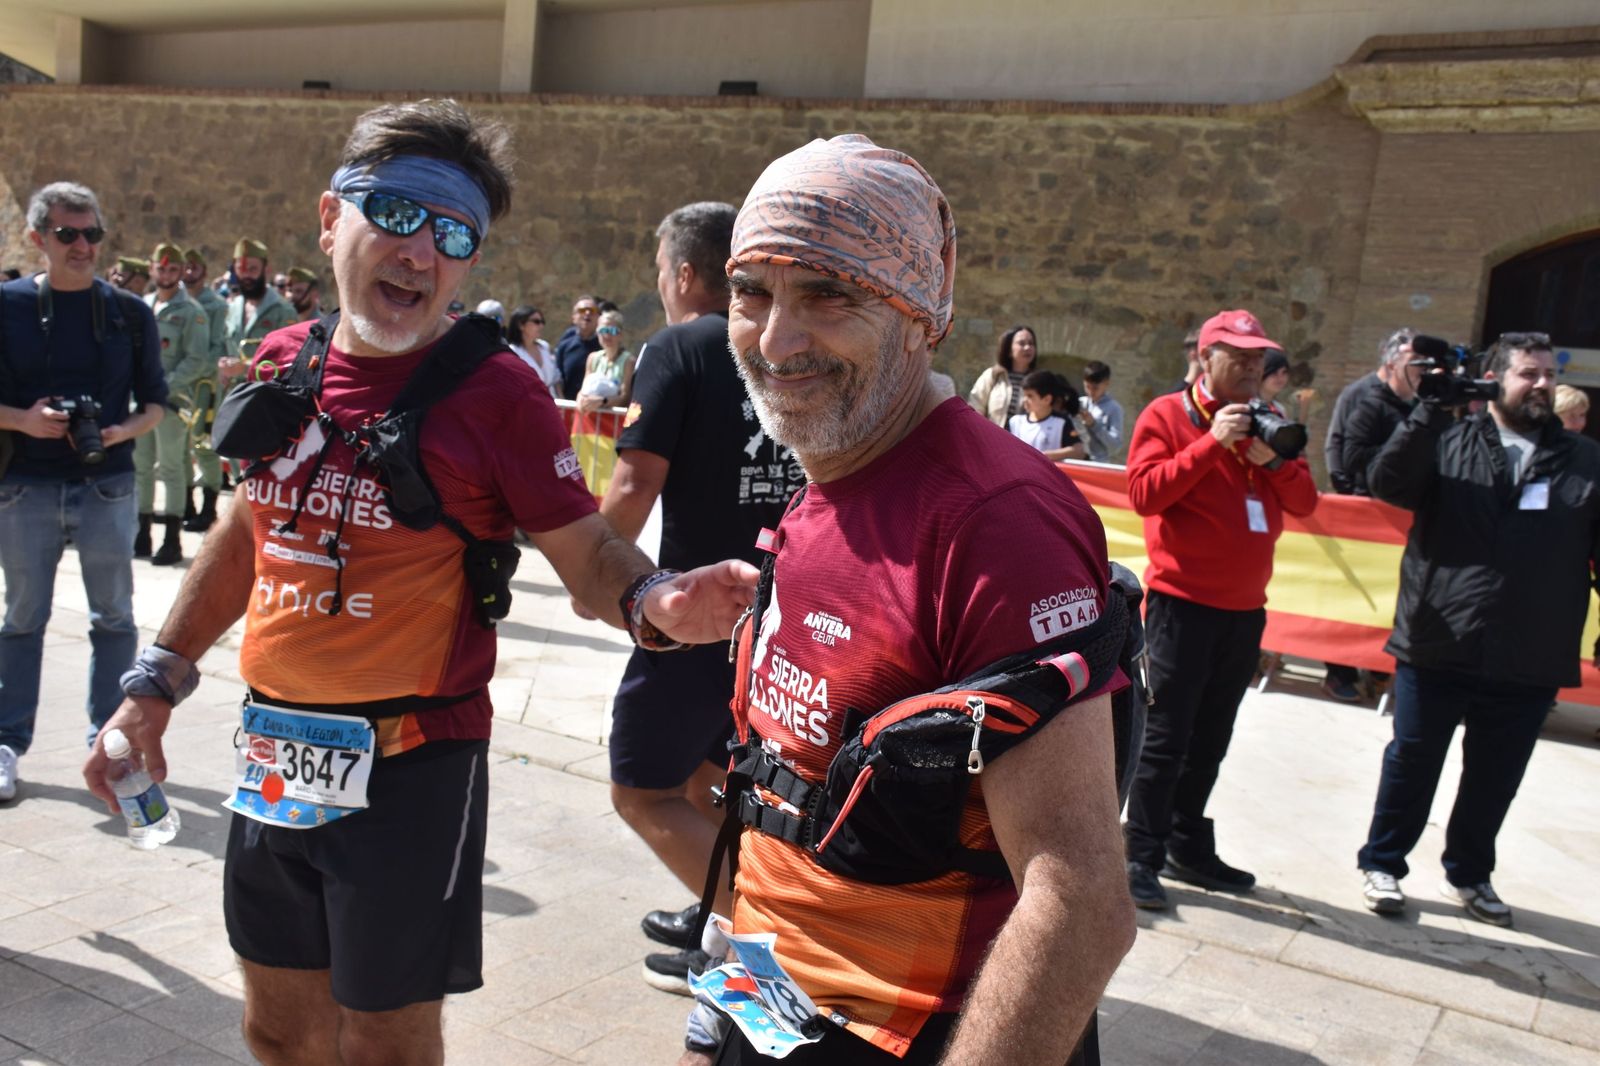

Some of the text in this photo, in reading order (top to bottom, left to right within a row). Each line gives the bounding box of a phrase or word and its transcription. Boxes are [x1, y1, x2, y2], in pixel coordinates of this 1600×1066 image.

[246, 477, 393, 530] BULLONES
[1031, 586, 1097, 617] ASOCIACIÓN
[803, 612, 851, 641] ANYERA
[811, 630, 835, 647] CEUTA
[768, 655, 829, 710] SIERRA
[750, 671, 830, 747] LLONES
[282, 743, 361, 791] 3647
